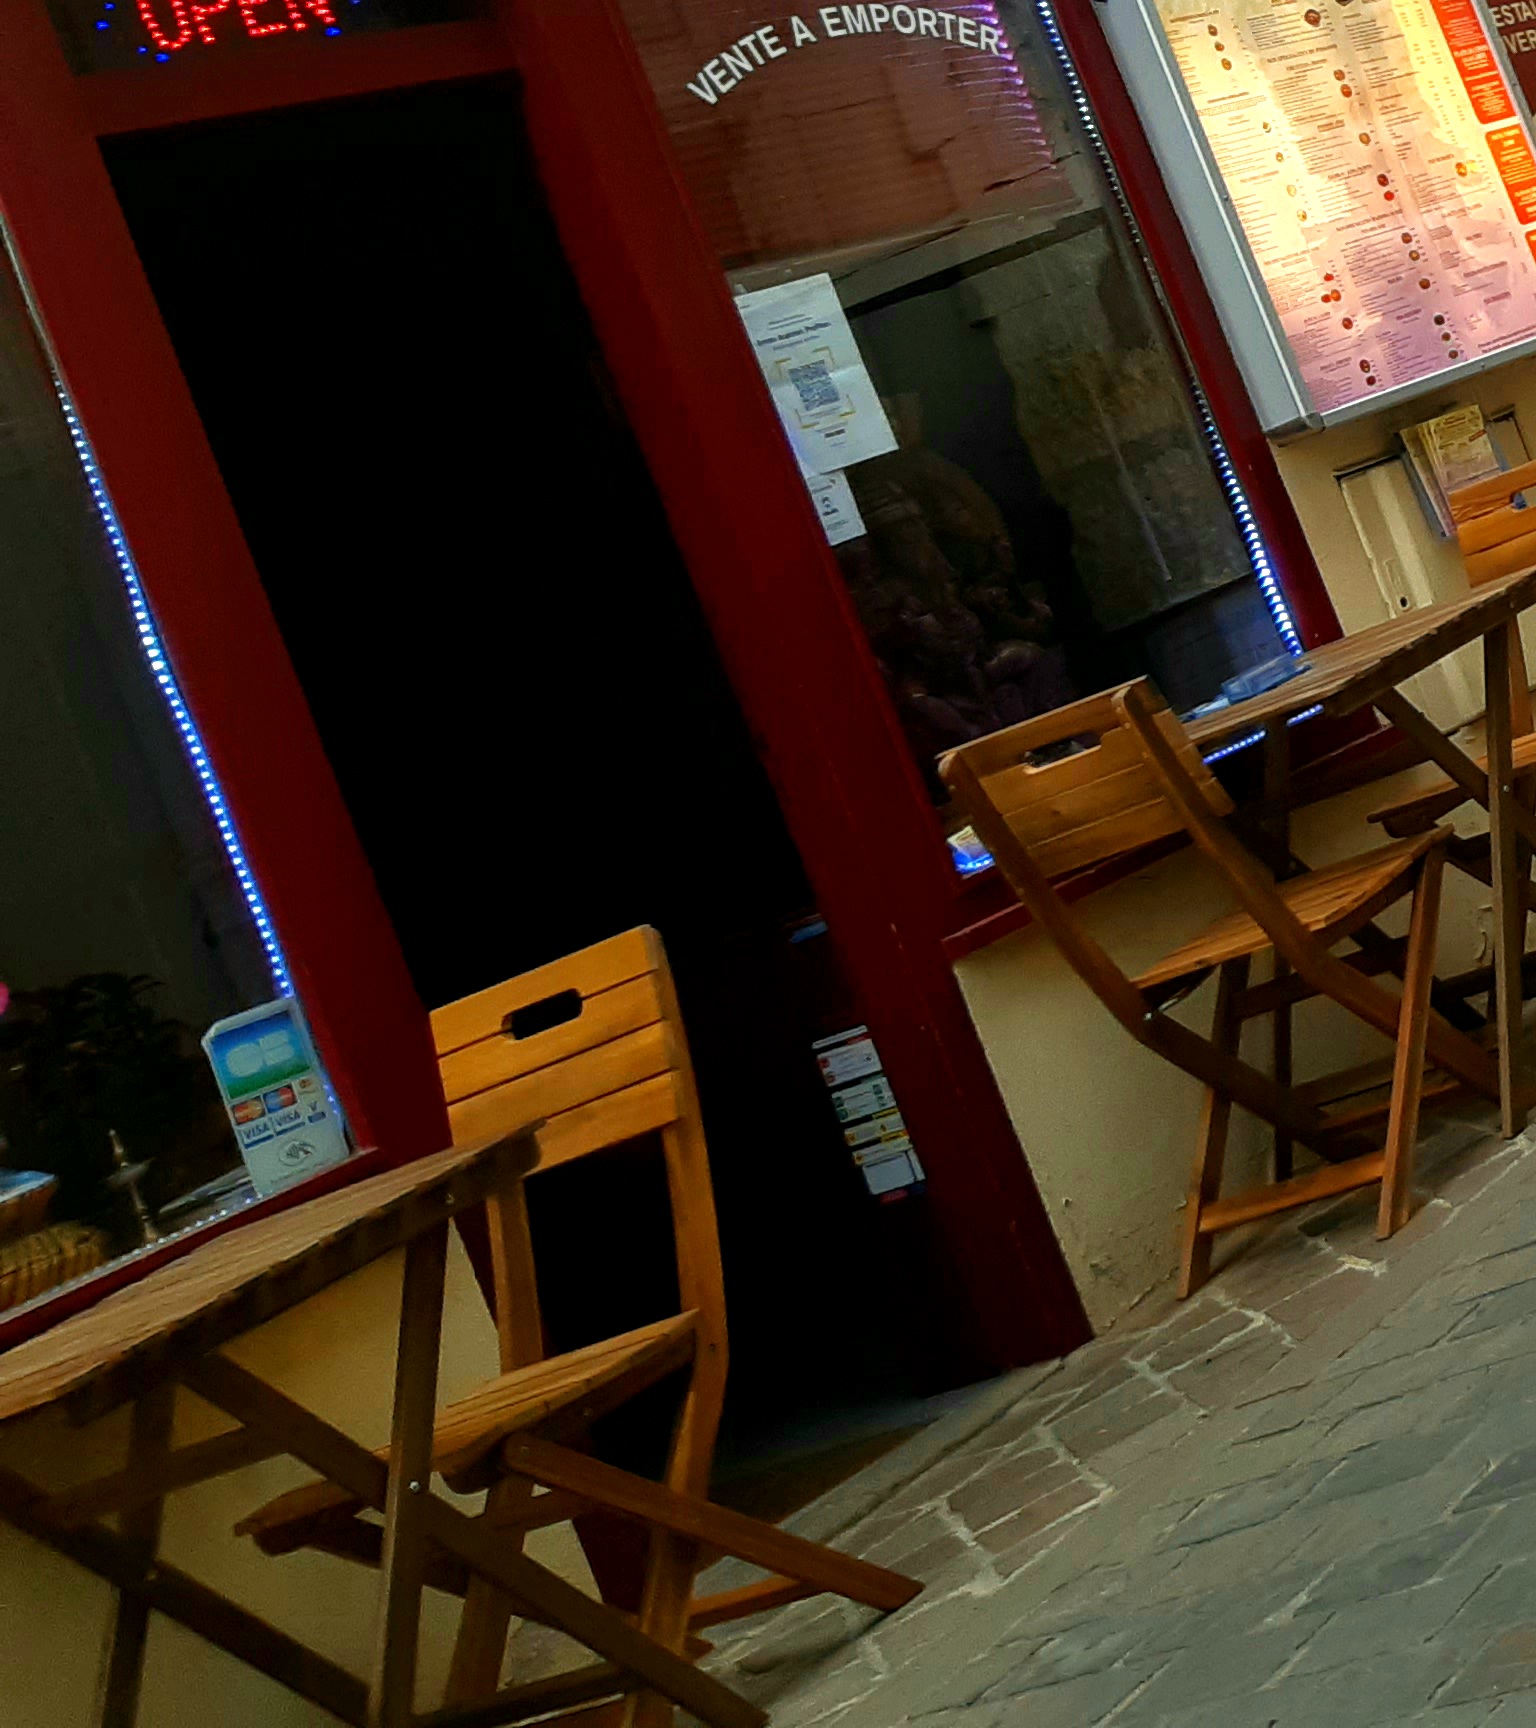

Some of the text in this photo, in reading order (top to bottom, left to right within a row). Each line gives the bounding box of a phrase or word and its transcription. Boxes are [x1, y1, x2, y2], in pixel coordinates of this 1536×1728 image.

[686, 2, 1000, 106] VENTE A EMPORTER
